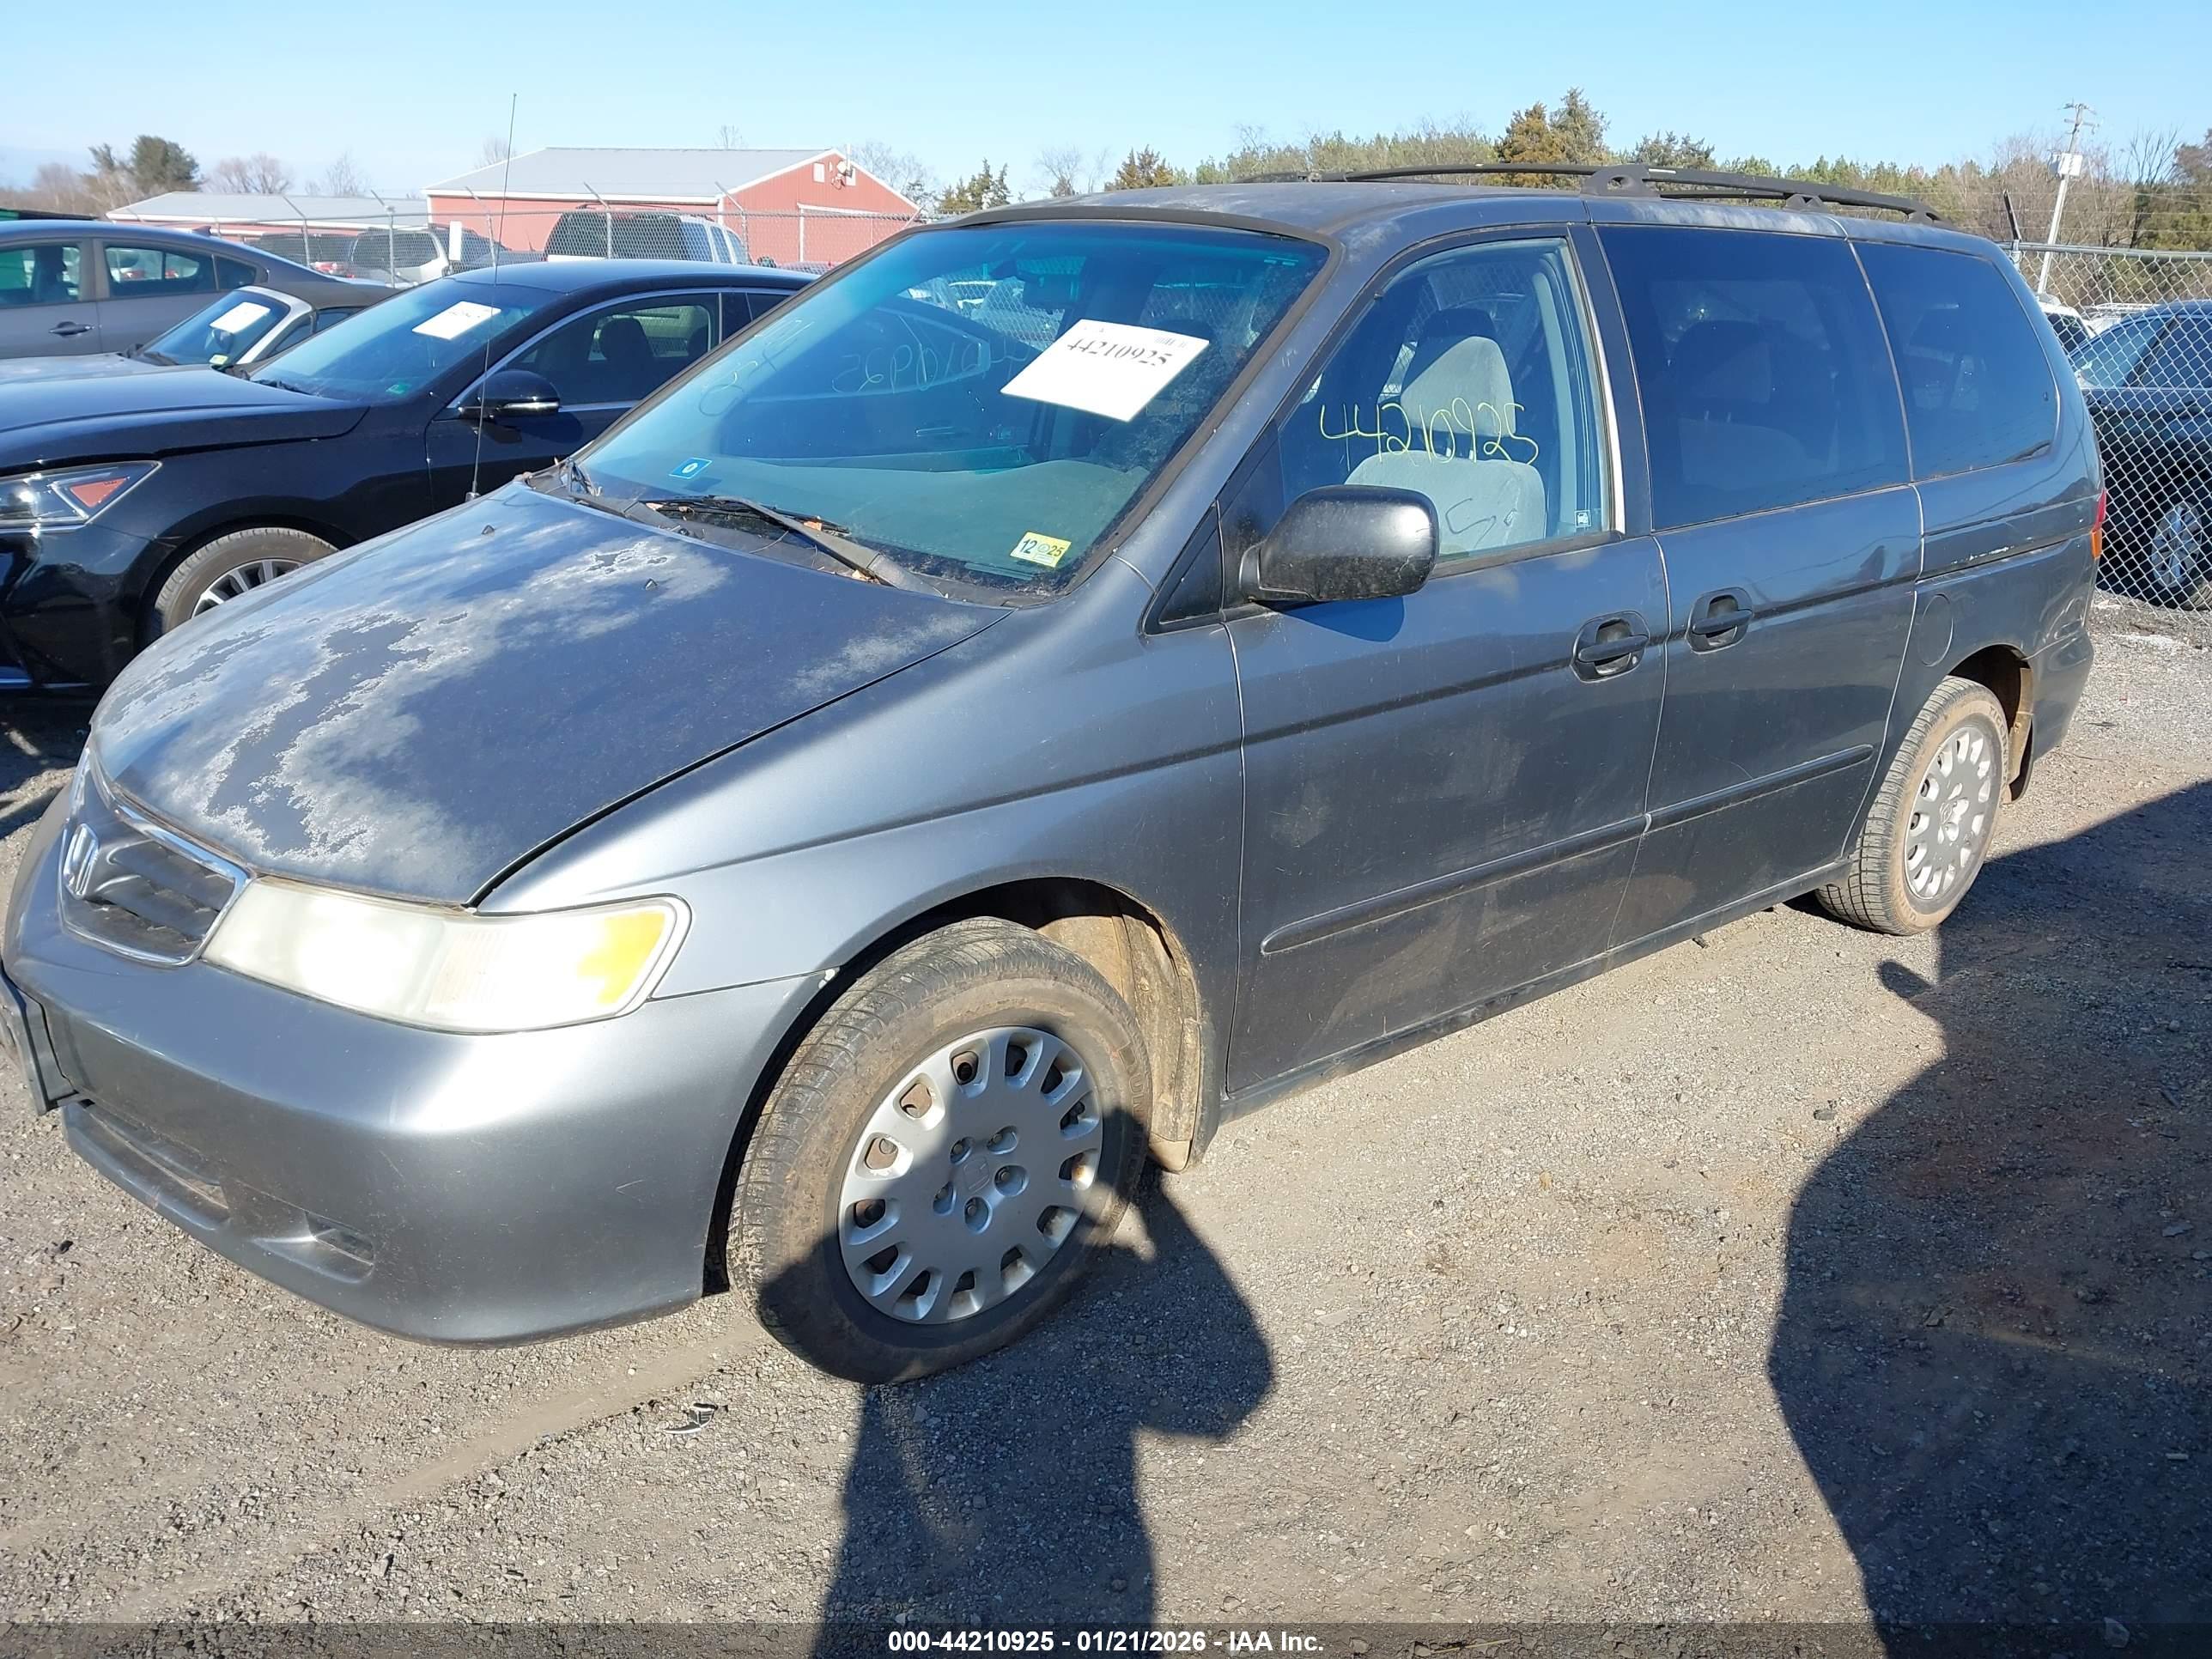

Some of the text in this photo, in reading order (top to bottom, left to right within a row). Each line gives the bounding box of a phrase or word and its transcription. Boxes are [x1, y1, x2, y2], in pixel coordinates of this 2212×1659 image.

[1066, 337, 1173, 367] 44210925
[1320, 397, 1540, 472] 44210925
[1019, 538, 1066, 557] 12 25
